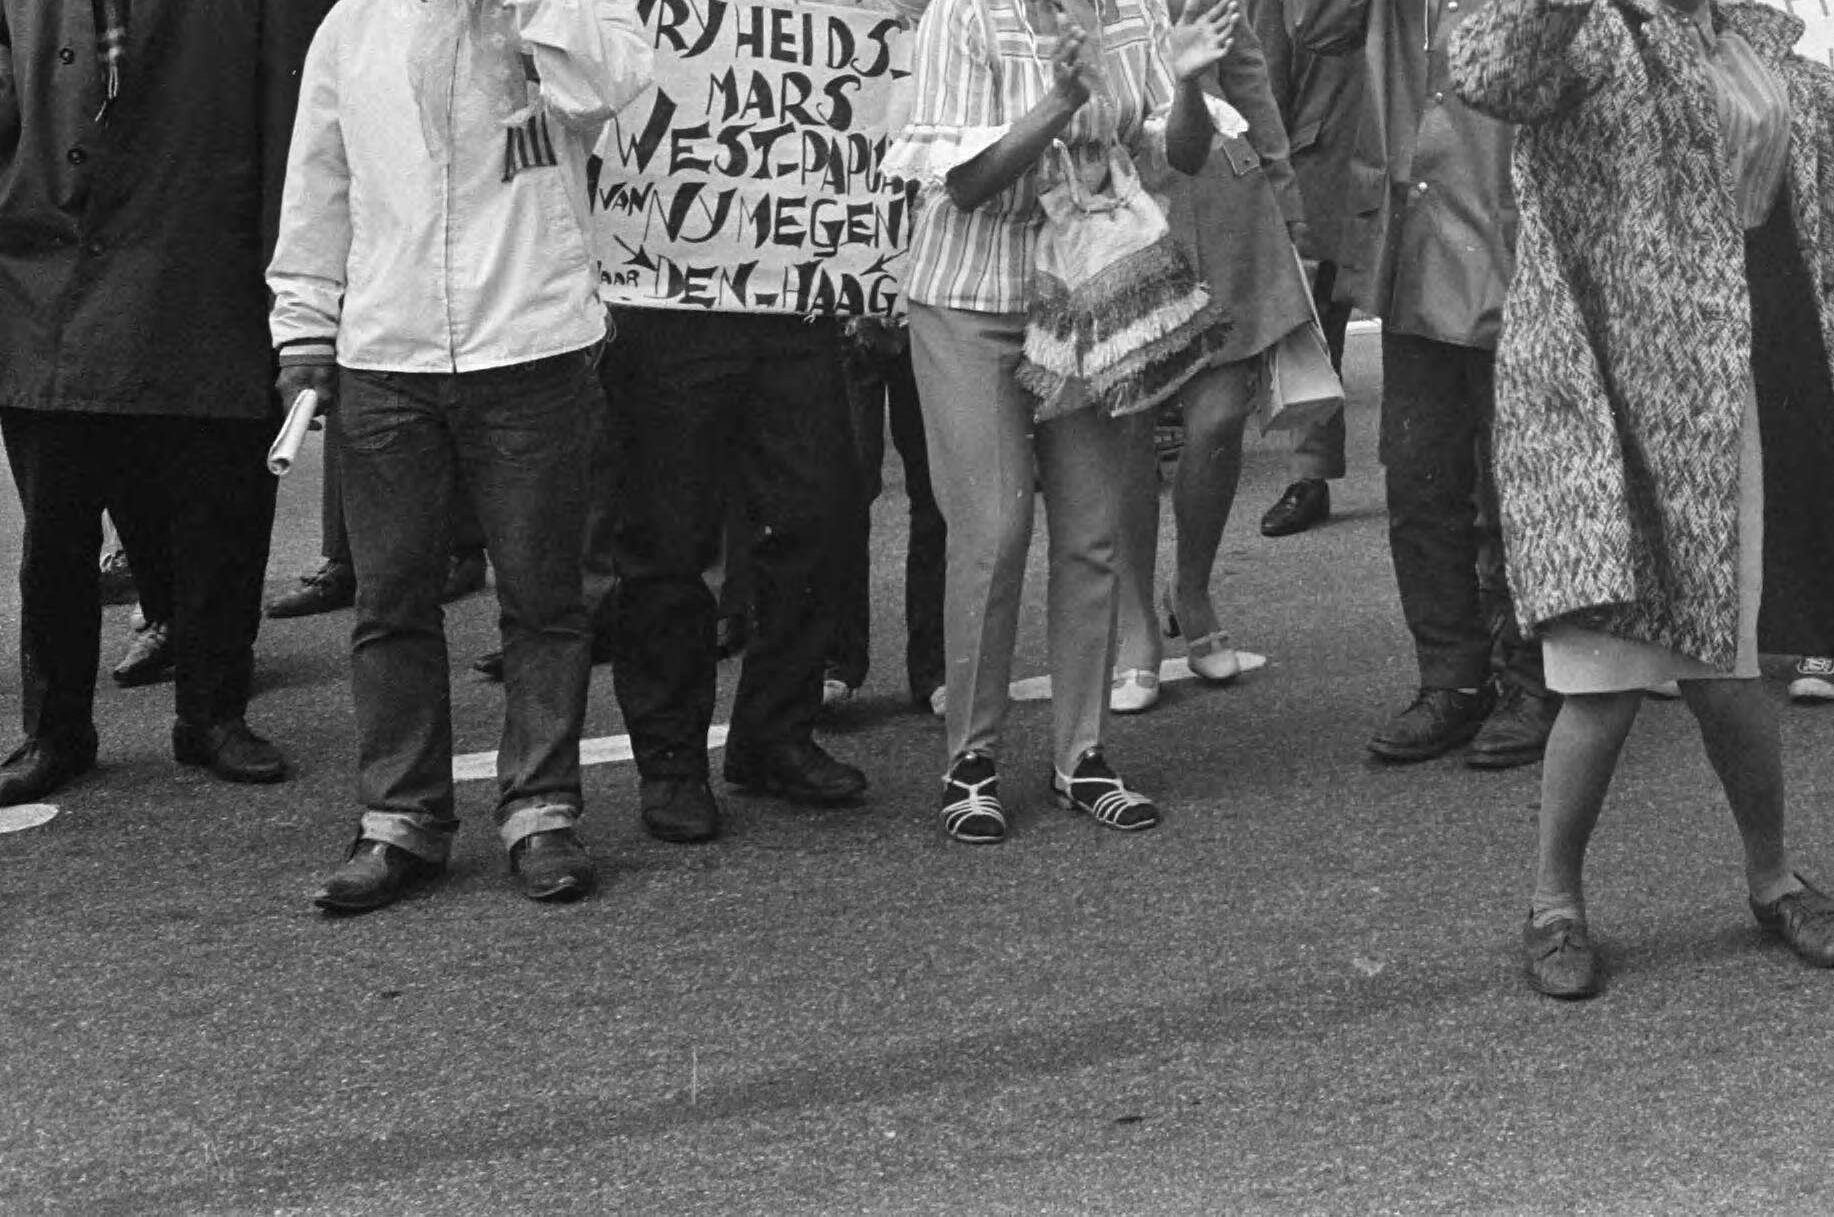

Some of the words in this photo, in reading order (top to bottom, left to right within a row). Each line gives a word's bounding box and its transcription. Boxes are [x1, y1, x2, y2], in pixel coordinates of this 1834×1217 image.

[706, 64, 861, 132] MARS
[599, 182, 655, 217] VAN
[597, 259, 640, 287] AAR
